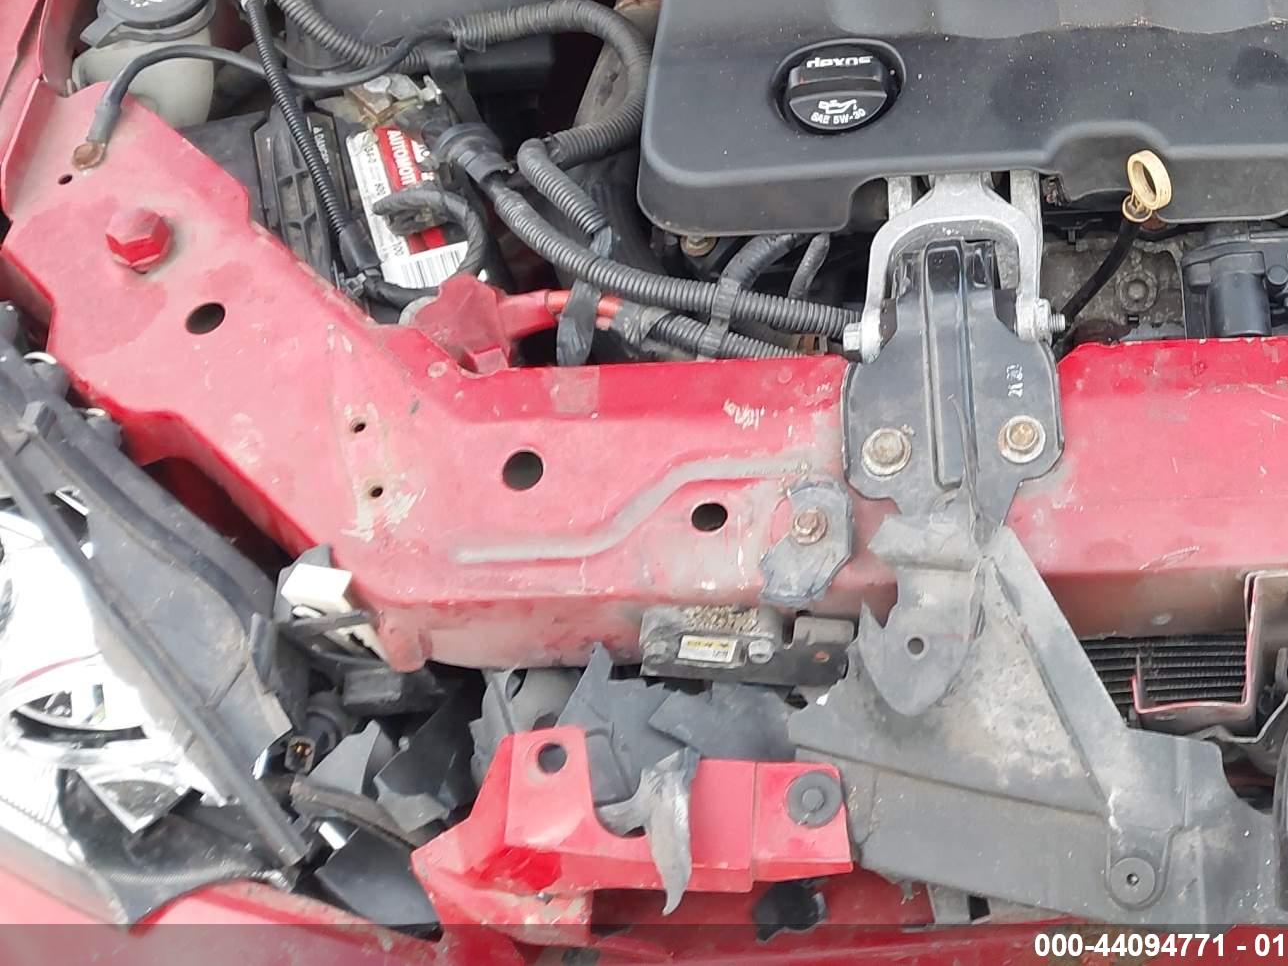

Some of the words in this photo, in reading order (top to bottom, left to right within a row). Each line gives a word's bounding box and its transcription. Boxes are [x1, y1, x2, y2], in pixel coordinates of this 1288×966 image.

[810, 111, 831, 124] SAE
[833, 108, 866, 124] 5W-30
[386, 130, 417, 186] AUTOMOTI
